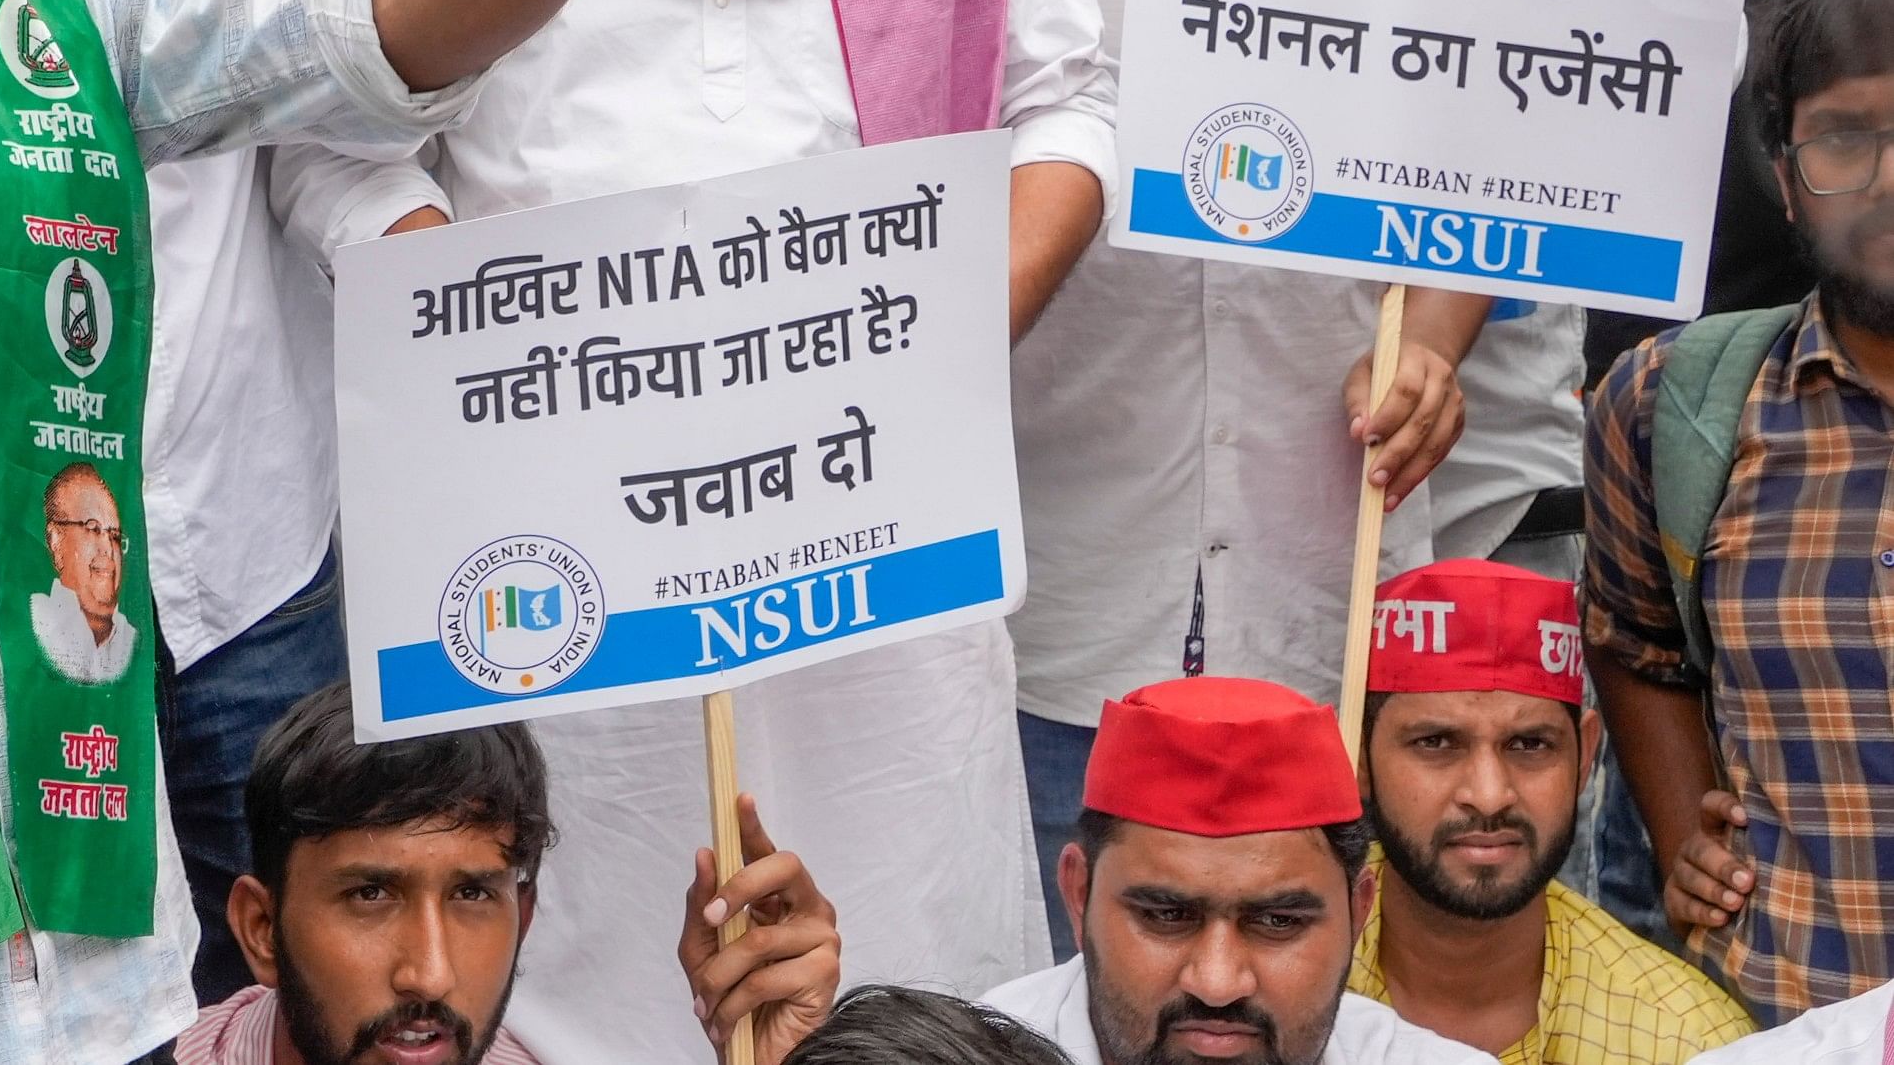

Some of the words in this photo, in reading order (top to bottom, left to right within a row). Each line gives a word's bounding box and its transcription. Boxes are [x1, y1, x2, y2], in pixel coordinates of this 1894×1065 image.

[1392, 26, 1475, 88] ठग
[1497, 29, 1682, 117] एजेंसी
[14, 102, 95, 142] राष्ट्रीय
[1277, 123, 1306, 170] UNION
[2, 140, 74, 173] जनता
[81, 149, 120, 179] दल
[1190, 152, 1225, 226] NATIONAL
[1295, 176, 1307, 198] OF
[1336, 158, 1471, 196] #NTABAN
[1482, 177, 1621, 215] #RENEET
[22, 214, 120, 254] लालटेन
[1263, 200, 1299, 231] INDIA
[1373, 205, 1548, 278] NSUI
[413, 254, 582, 338] आखिर
[597, 245, 705, 309] NTA
[713, 217, 770, 290] को
[779, 206, 850, 274] बैन
[859, 183, 945, 258] क्यों
[456, 345, 568, 424] नहीं
[571, 336, 705, 410] किया
[714, 328, 767, 388] जा
[779, 308, 852, 372] रहा
[861, 284, 918, 355] है?
[620, 444, 797, 528] जवाब
[818, 406, 876, 491] दो
[548, 548, 592, 596] UNION
[655, 552, 780, 599] #NTABAN
[788, 521, 900, 569] #RENEET
[582, 601, 596, 626] OF
[691, 564, 876, 667] NSUI
[447, 609, 502, 684] NATIONAL
[549, 631, 591, 674] INDIA
[61, 725, 119, 777] राष्ट्रीय
[39, 779, 102, 820] जनता
[103, 784, 127, 821] दल
